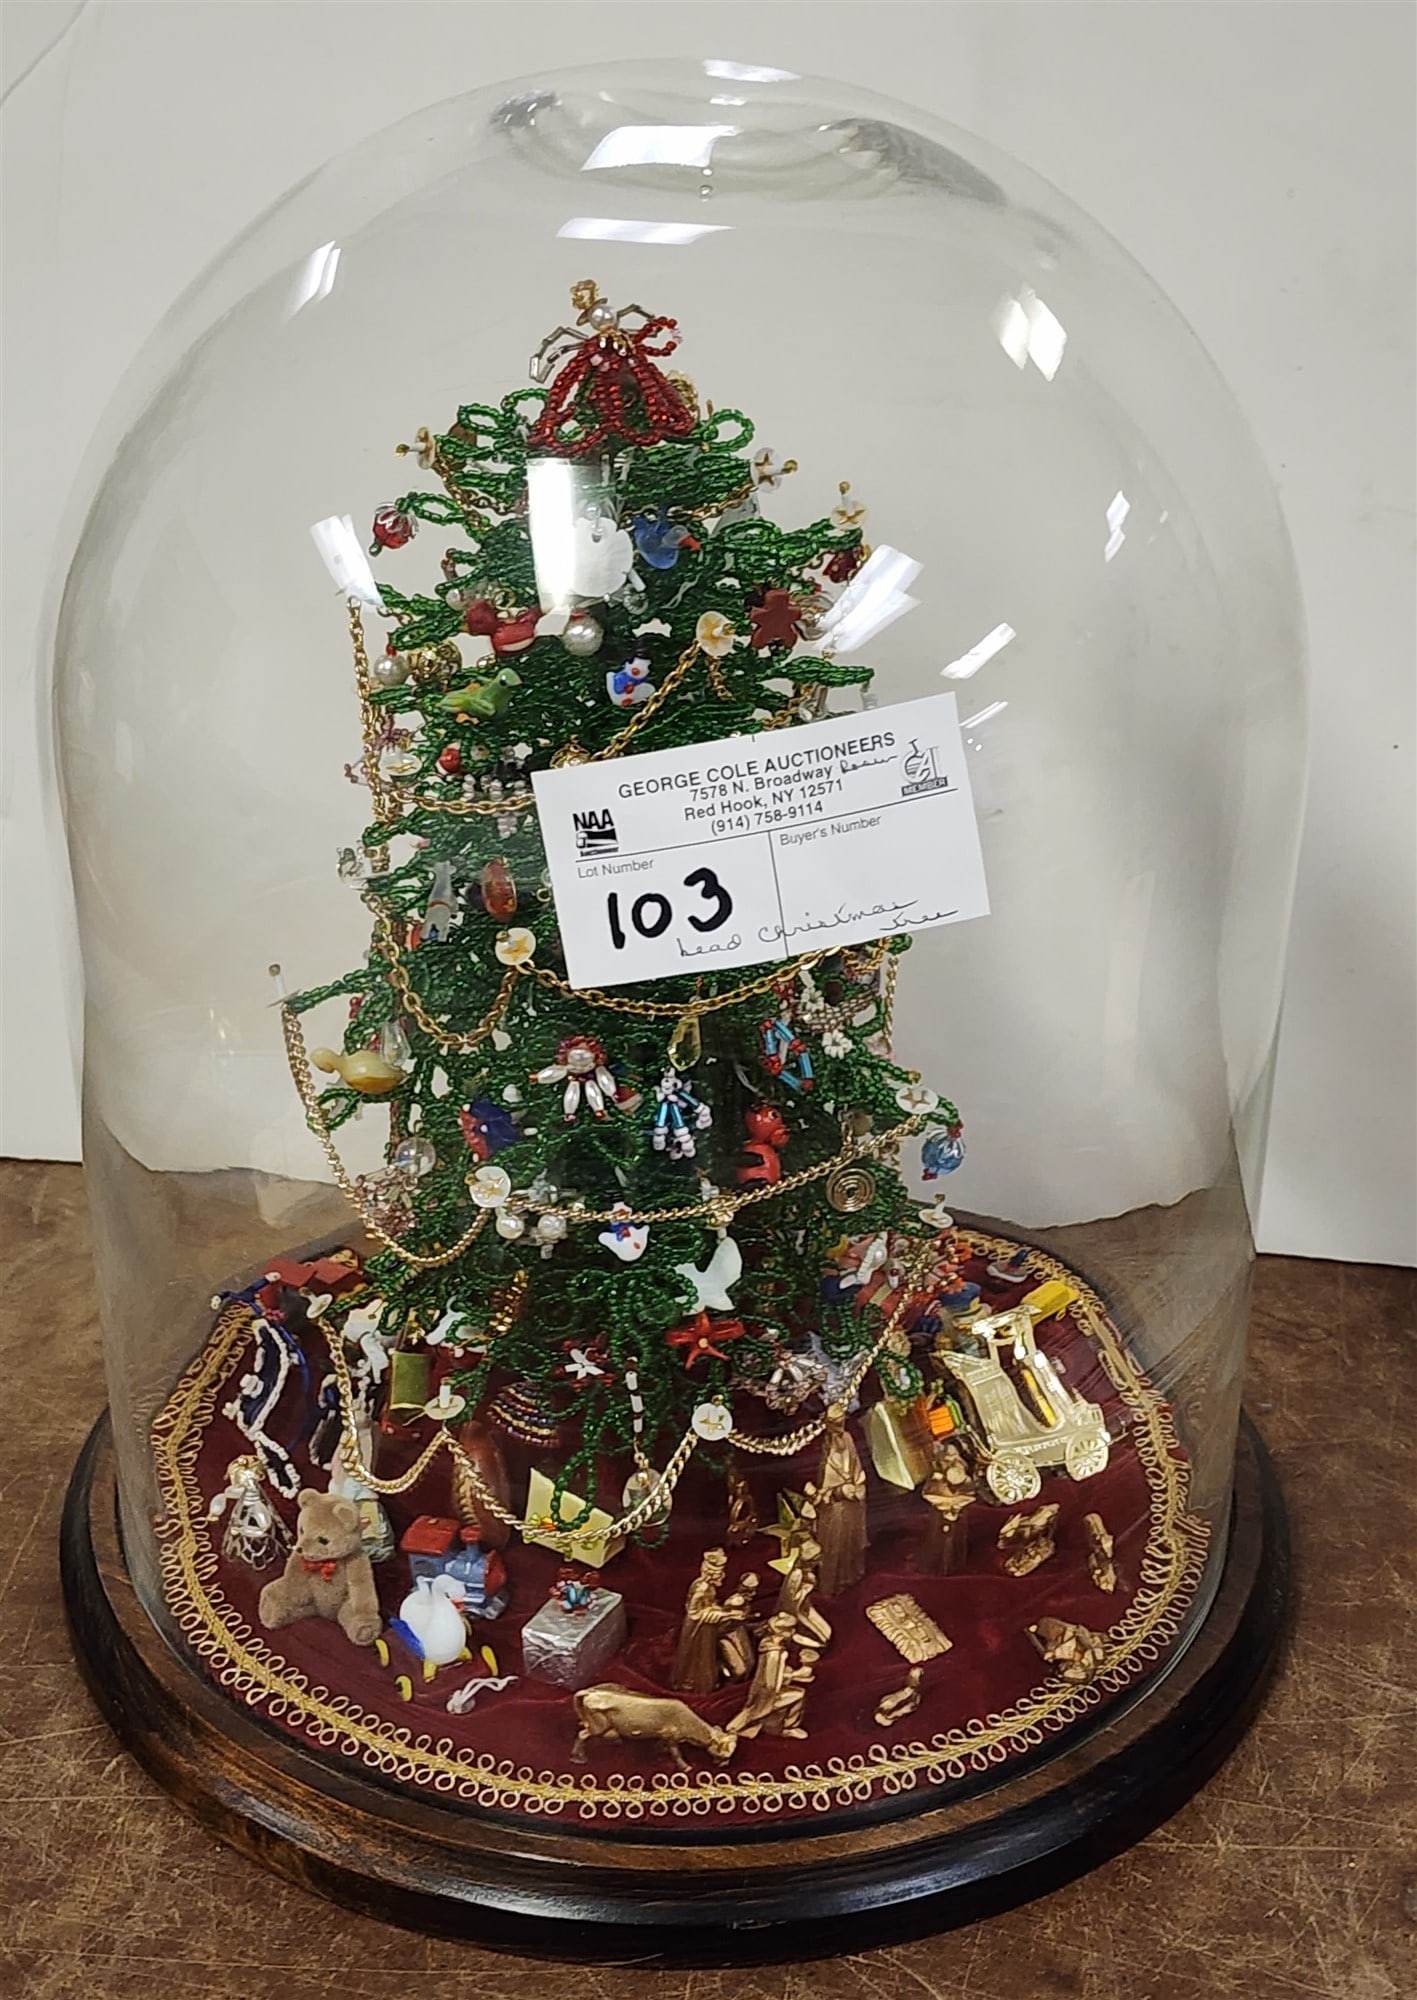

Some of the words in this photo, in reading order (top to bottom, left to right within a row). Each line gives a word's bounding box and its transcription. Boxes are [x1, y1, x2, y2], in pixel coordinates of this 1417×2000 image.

[618, 771, 701, 799] GEORGE
[706, 760, 760, 784] COLE
[764, 732, 896, 773] AUCTIONEERS
[689, 783, 728, 802] 7578
[733, 781, 749, 795] N.
[754, 764, 833, 790] Broadway
[684, 803, 716, 821] Red
[721, 795, 768, 815] Hook,
[772, 788, 795, 805] NY
[799, 778, 843, 799] 12571
[901, 777, 948, 796] MEMBER
[572, 808, 615, 832] NAA
[711, 814, 751, 836] (914)
[755, 800, 823, 826] 758-9114
[779, 827, 828, 846] Buyer's
[830, 815, 882, 835] Number
[577, 865, 599, 879] Lot
[602, 859, 655, 876] Number
[607, 867, 733, 949] 103
